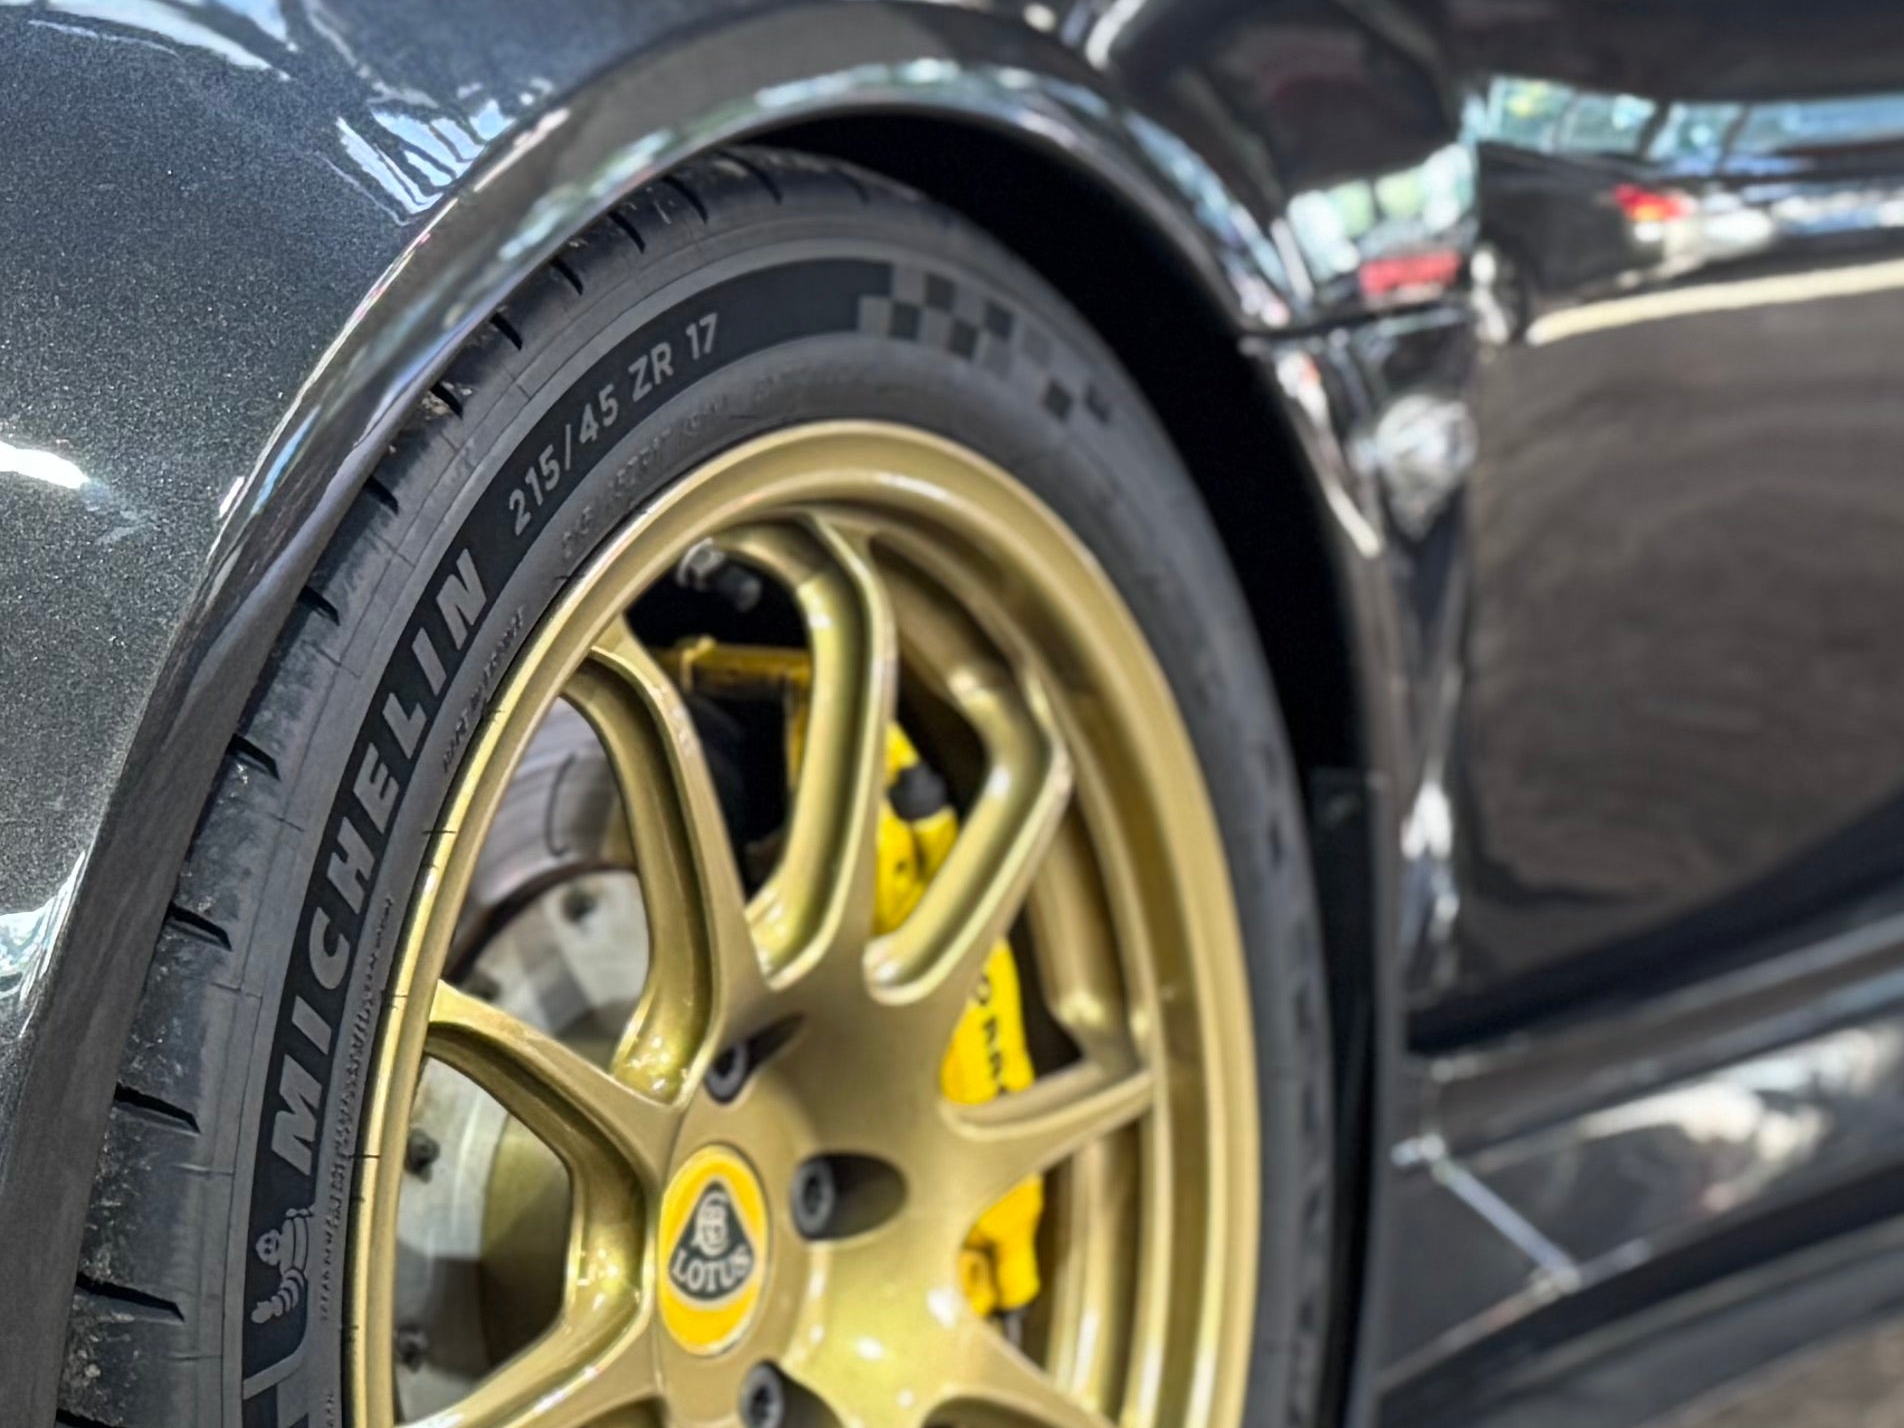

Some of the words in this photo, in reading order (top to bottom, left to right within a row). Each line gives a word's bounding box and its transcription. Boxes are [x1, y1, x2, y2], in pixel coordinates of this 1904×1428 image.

[507, 382, 619, 536] 215/45
[627, 341, 675, 402] ZR
[685, 312, 718, 360] 17
[270, 545, 487, 1177] MICHELIN
[671, 1243, 752, 1293] LOTUS
